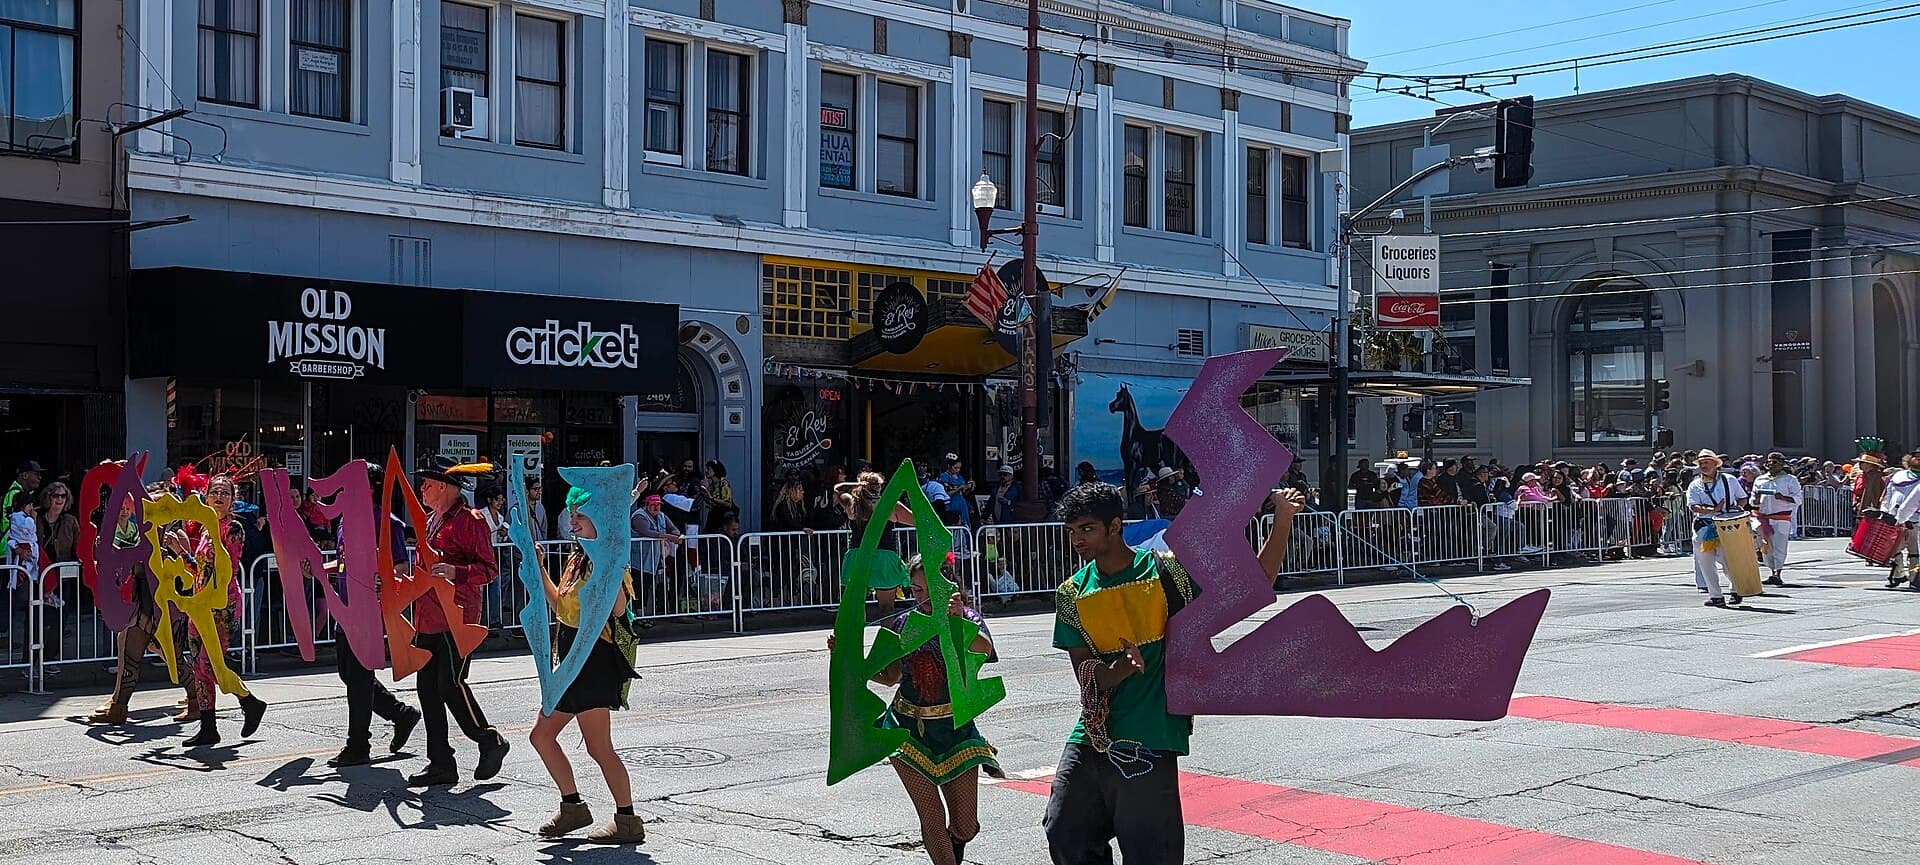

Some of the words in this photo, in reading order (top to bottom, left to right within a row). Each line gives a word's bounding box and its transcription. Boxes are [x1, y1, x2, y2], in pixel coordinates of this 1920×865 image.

[1381, 245, 1437, 260] Groceries
[1385, 263, 1430, 281] Liquors
[301, 287, 352, 320] OLD
[896, 303, 915, 328] Rey
[267, 320, 386, 370] MISSION
[505, 319, 639, 369] cricket
[1279, 331, 1322, 346] GROCERIES
[301, 363, 353, 375] BARBERSHOP
[819, 389, 841, 401] OPEN
[786, 425, 800, 447] El
[801, 410, 827, 441] Rey
[225, 441, 252, 457] OLD
[447, 439, 453, 447] 4
[453, 439, 470, 447] lines
[441, 447, 476, 456] UNLIMITED
